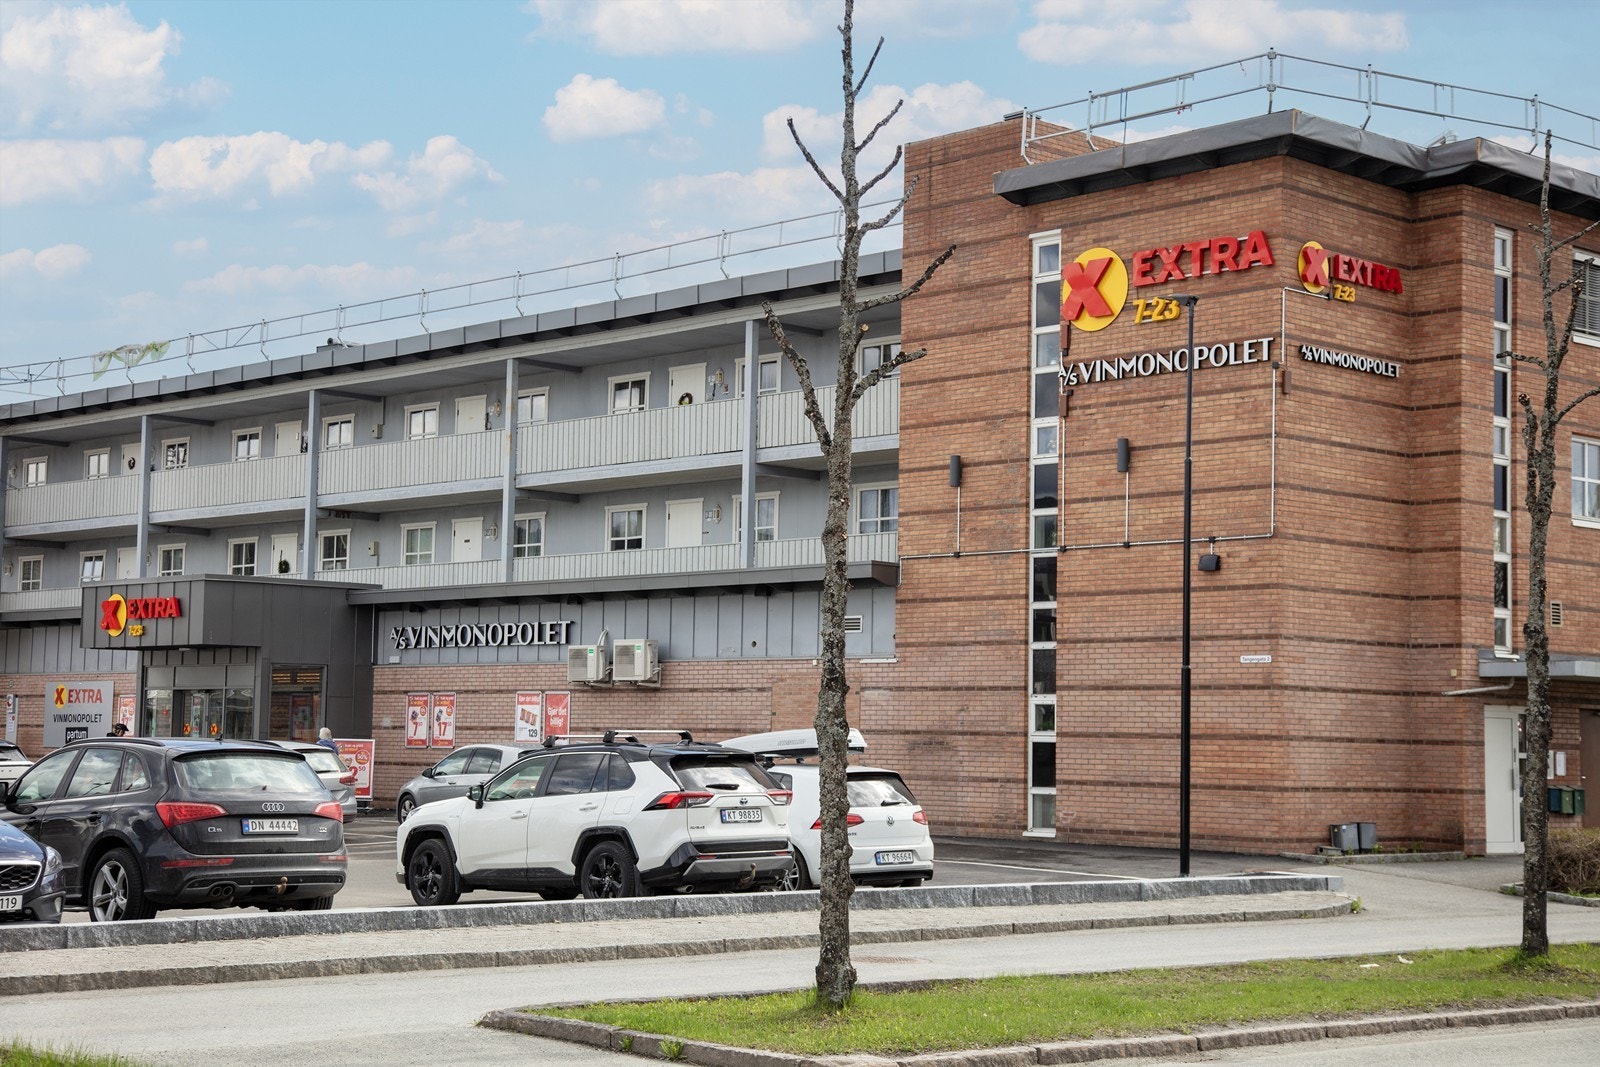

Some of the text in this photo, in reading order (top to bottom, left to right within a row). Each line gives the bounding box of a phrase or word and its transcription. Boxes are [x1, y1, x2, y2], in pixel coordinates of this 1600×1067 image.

[1132, 230, 1275, 287] EXTRA
[1333, 254, 1403, 294] EXTRA
[1333, 284, 1356, 303] 7-23
[1132, 297, 1181, 325] 7-23
[1079, 337, 1274, 383] VINMONOPOLET
[1312, 346, 1401, 378] VINMONOPOLET
[127, 596, 181, 619] EXTRA
[405, 620, 572, 649] VINMONOPOLET
[67, 689, 103, 704] EXTRA
[53, 713, 102, 723] VINMONOPOLET
[67, 730, 87, 742] partum
[412, 721, 418, 736] 7
[438, 721, 447, 736] 17
[528, 728, 538, 738] 129
[727, 810, 760, 819] KT 98835
[251, 820, 298, 830] DN 44442
[881, 852, 912, 862] KT 96664
